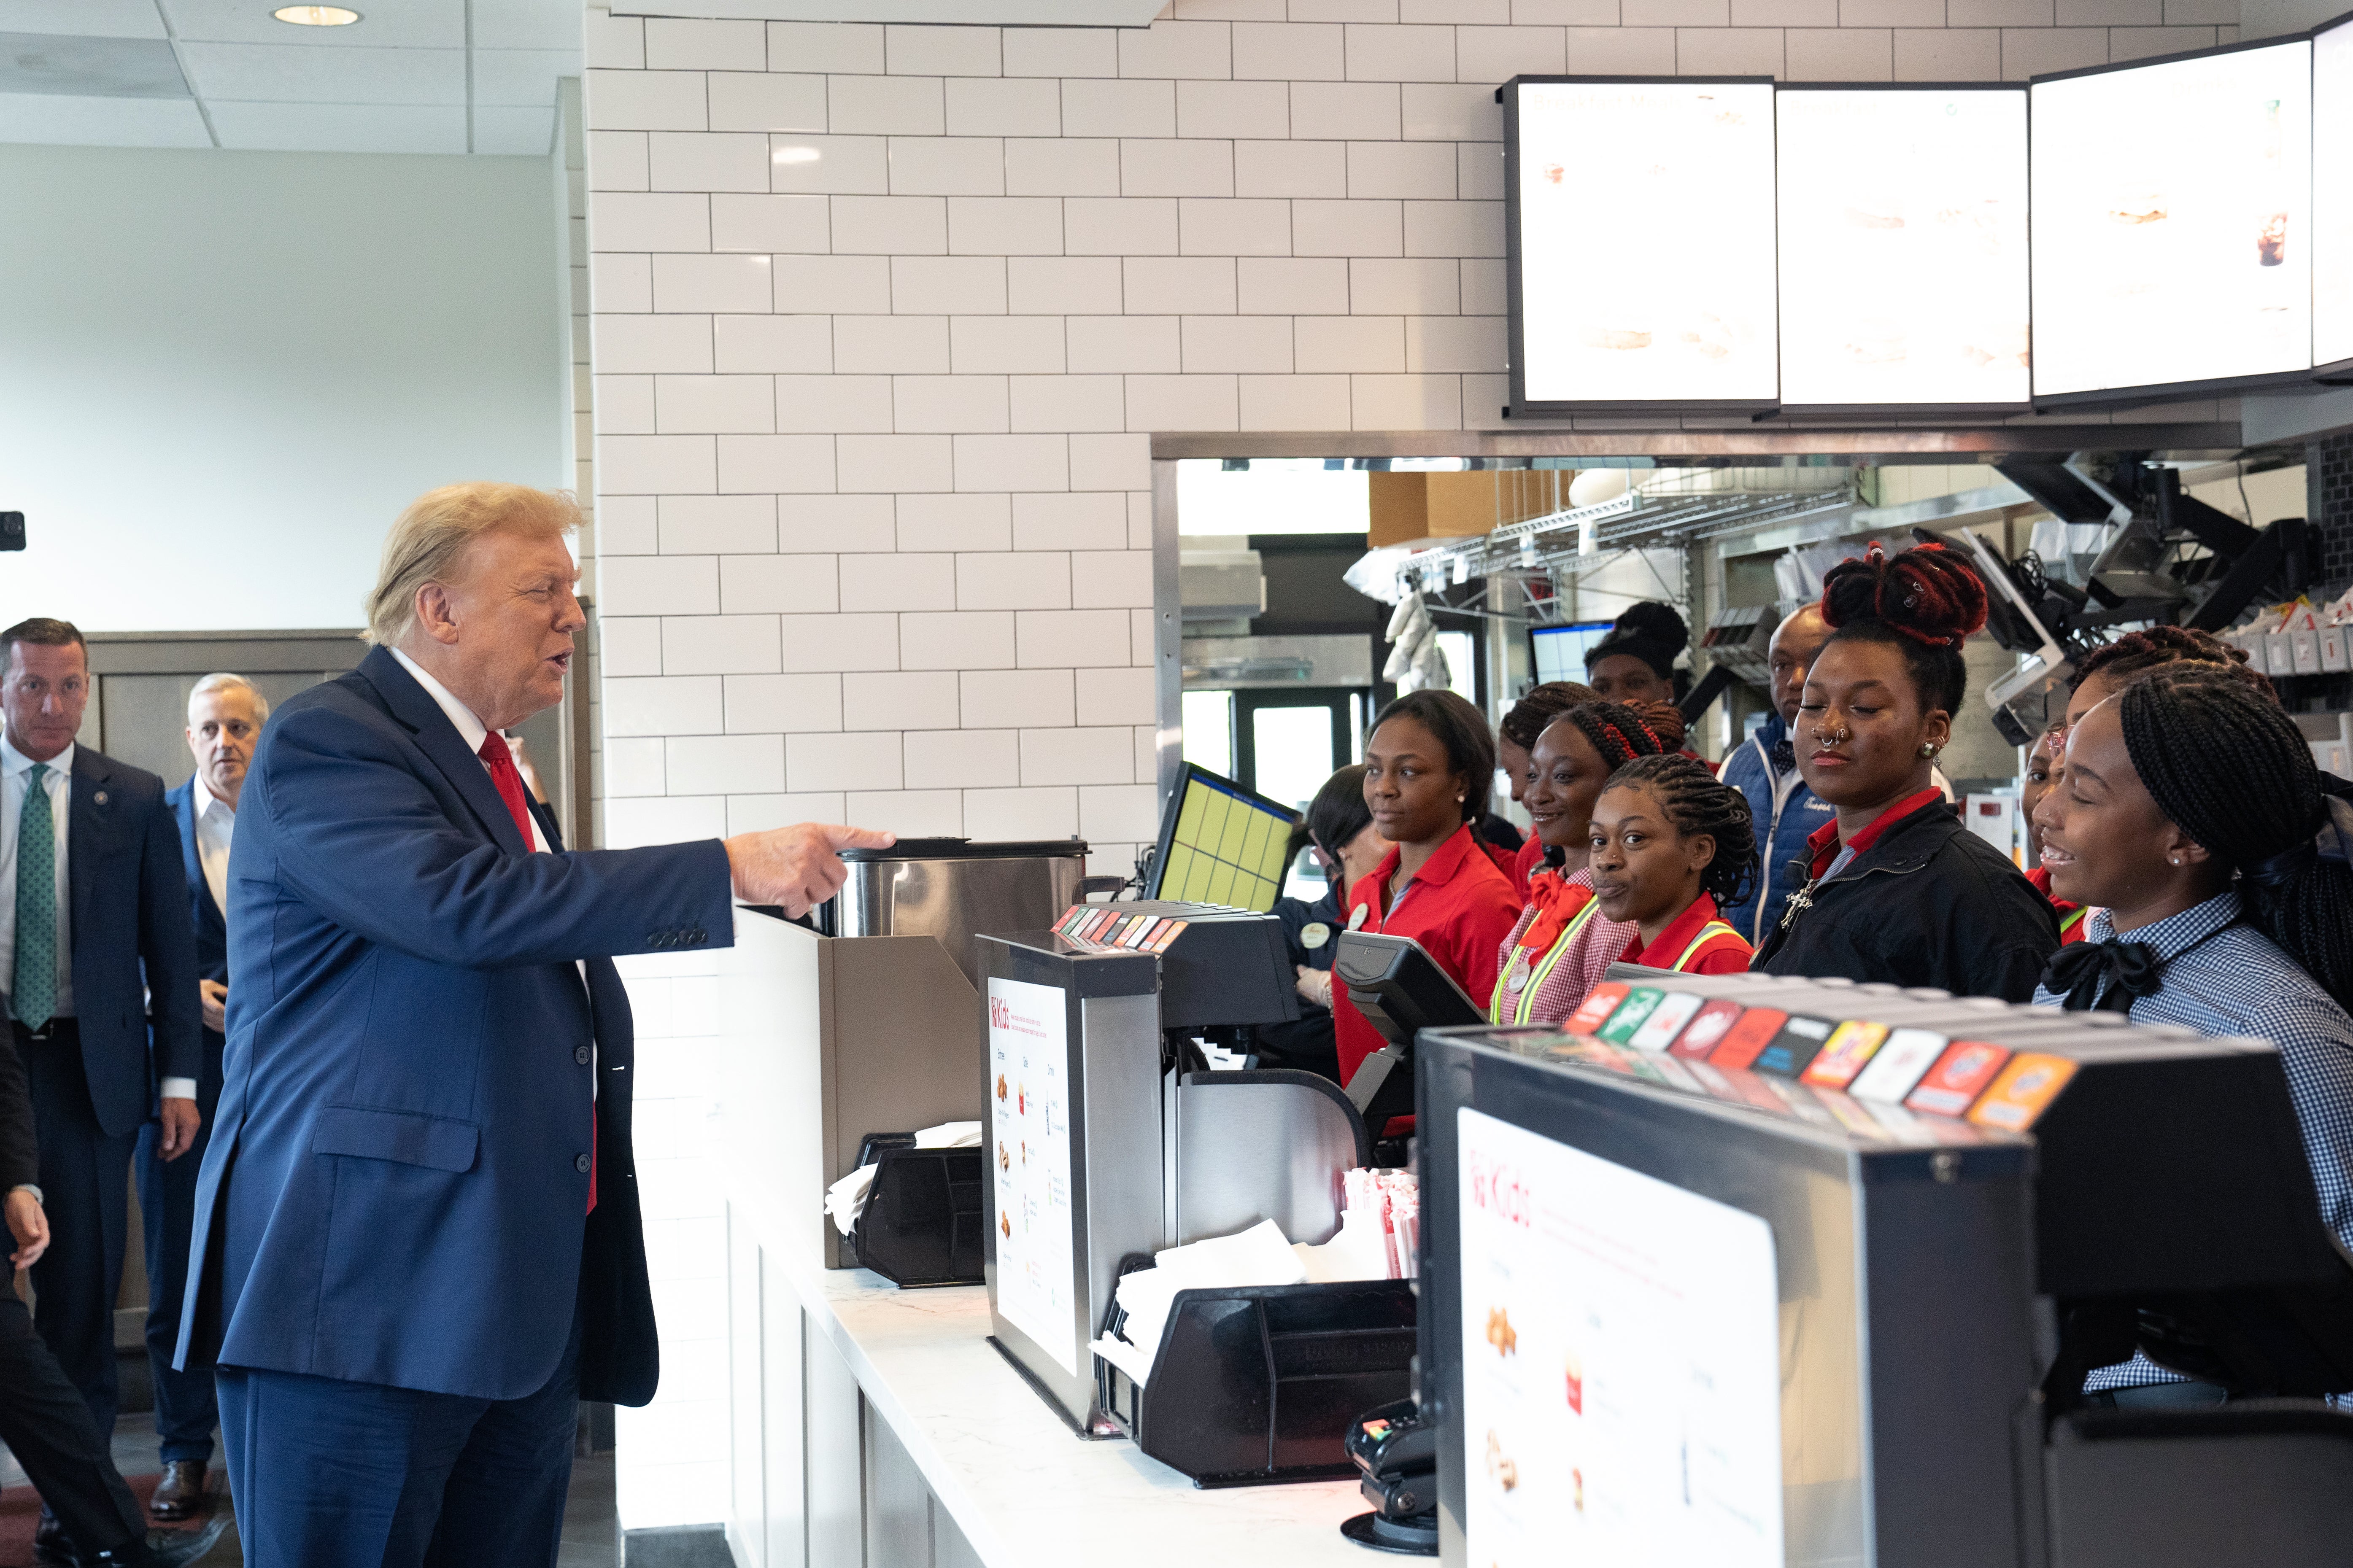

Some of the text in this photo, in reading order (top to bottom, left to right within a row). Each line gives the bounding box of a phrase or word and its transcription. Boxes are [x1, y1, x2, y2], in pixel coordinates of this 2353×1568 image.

[2172, 74, 2237, 99] Drinks
[1533, 93, 1682, 110] Breakfast Meals
[1790, 100, 1878, 116] Breakfast
[997, 997, 1009, 1030] Kids
[1490, 1158, 1531, 1229] Kids
